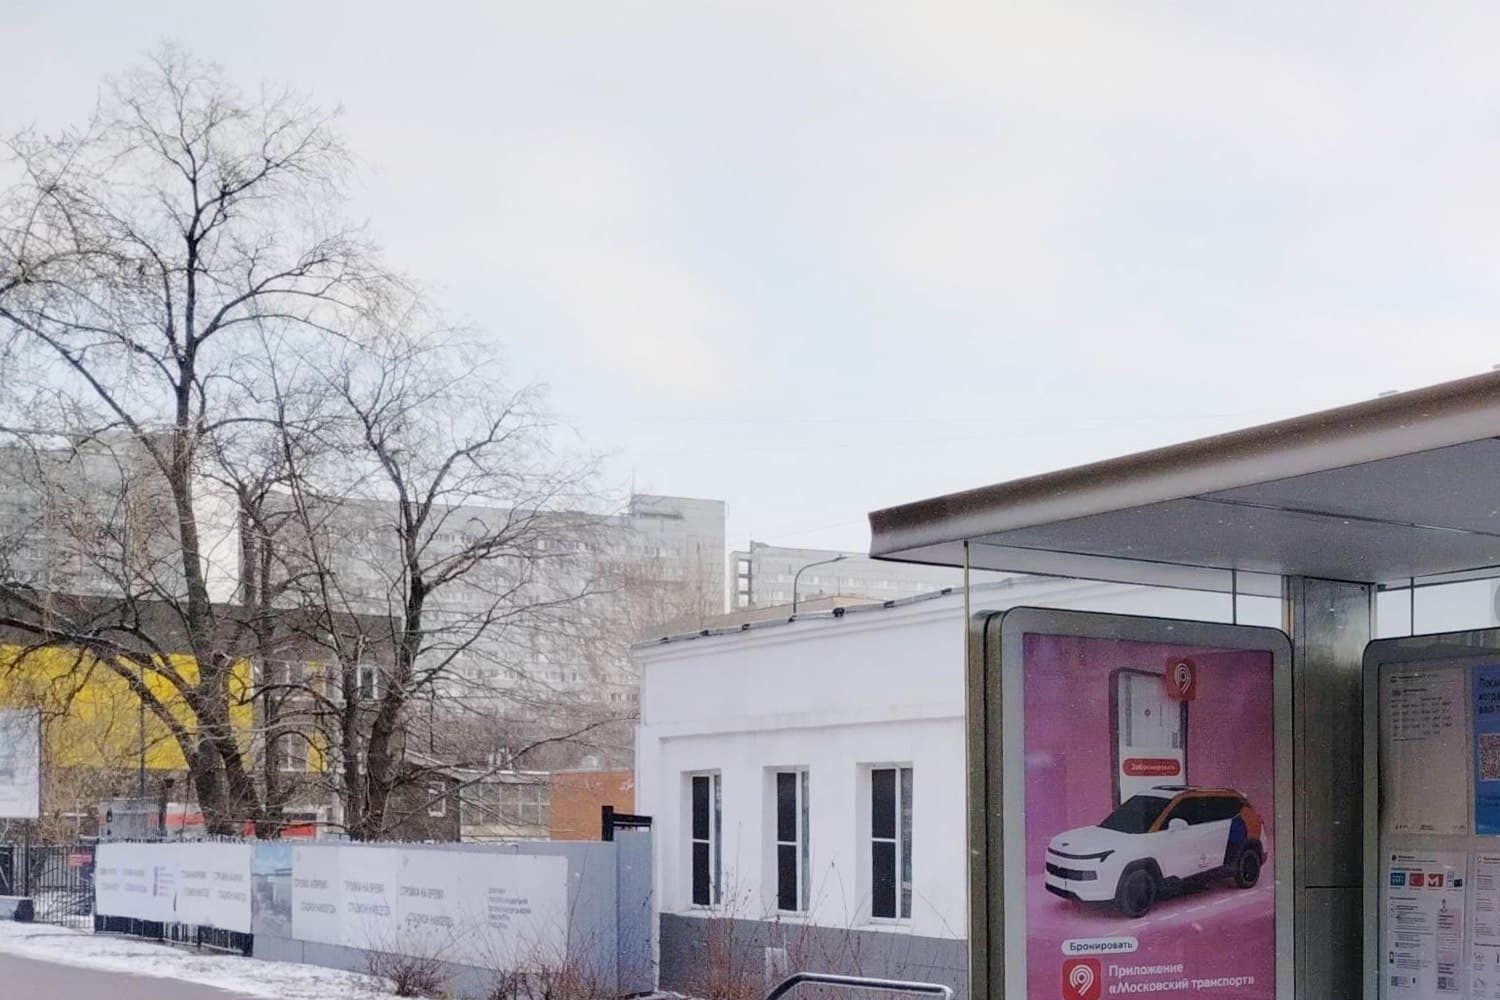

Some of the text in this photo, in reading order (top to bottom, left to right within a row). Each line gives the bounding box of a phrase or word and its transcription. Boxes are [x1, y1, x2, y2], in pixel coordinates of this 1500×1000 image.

[1069, 942, 1133, 953] Бронировать
[1108, 963, 1184, 978] Приложение
[1109, 976, 1255, 994] «Московский транспорт»
